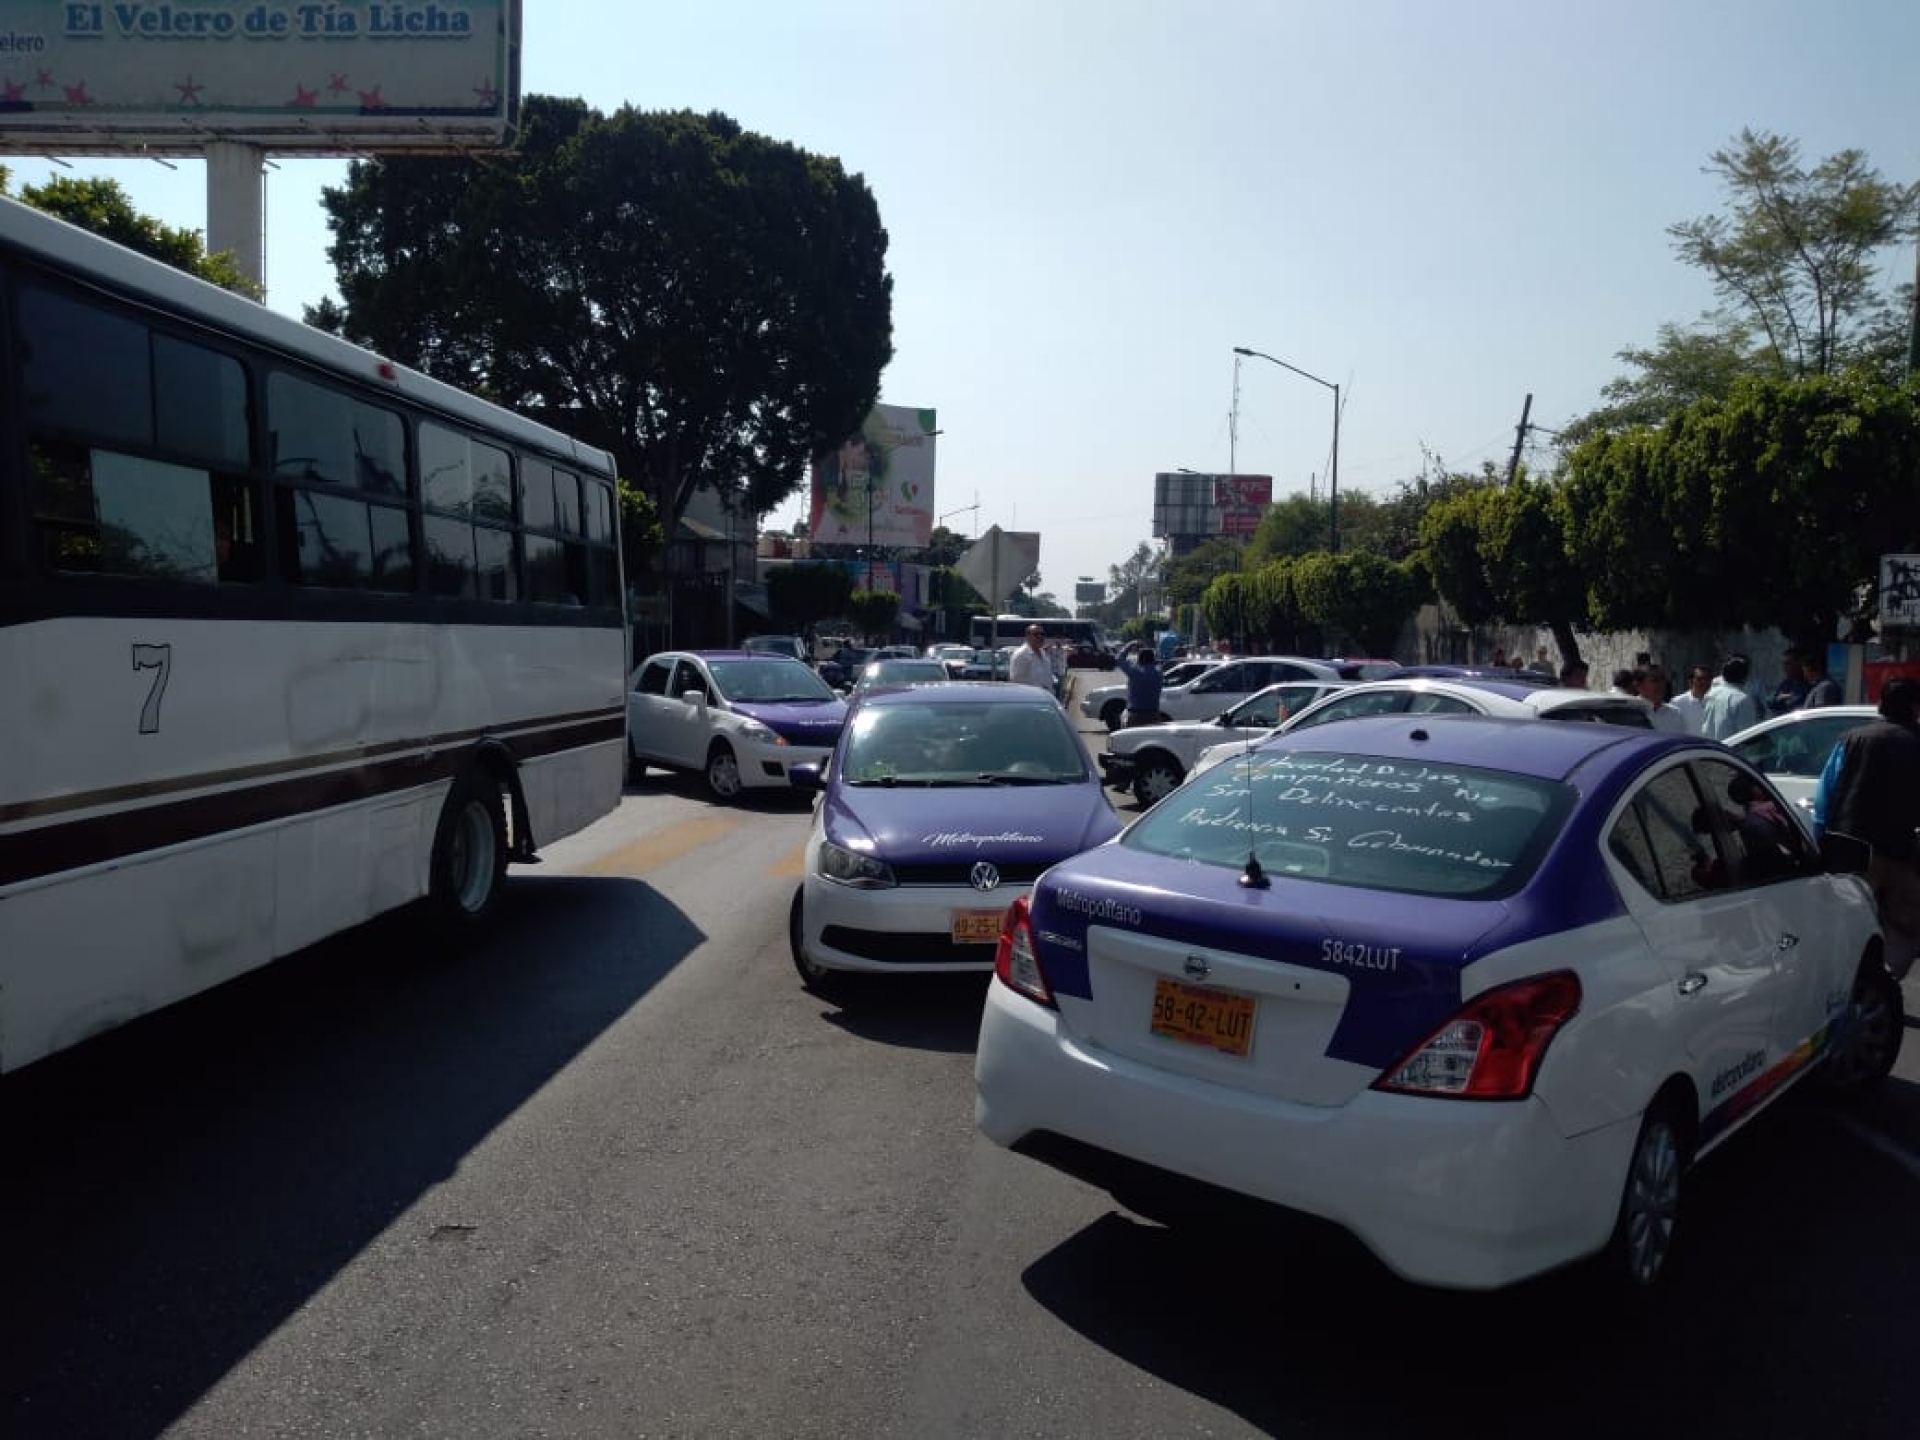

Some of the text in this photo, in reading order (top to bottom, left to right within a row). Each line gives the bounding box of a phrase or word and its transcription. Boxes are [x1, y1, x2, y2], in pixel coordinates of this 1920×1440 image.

[65, 3, 471, 32] El Velero de Tía Licha
[132, 643, 171, 735] 7
